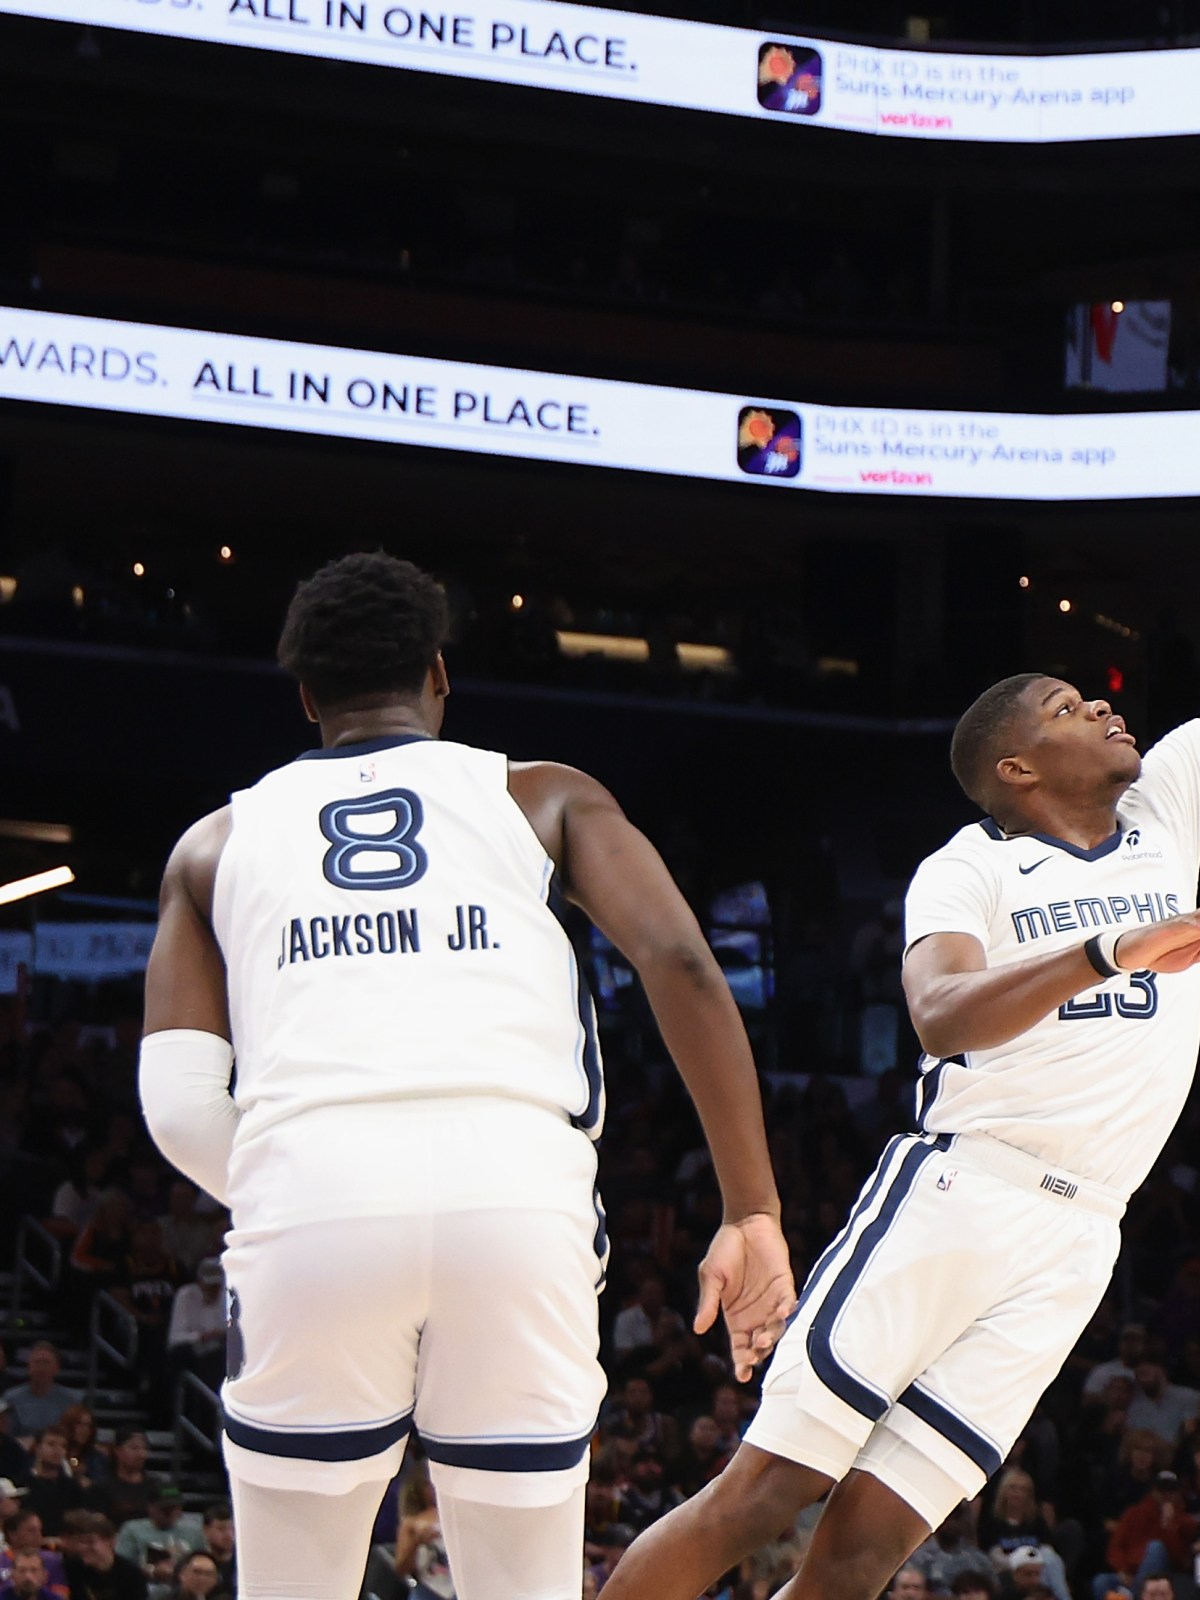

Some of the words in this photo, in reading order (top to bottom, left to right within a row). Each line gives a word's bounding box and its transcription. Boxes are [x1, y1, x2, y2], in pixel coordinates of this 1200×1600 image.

[229, 0, 309, 26] ALL
[325, 0, 366, 31] IN
[383, 7, 474, 48] ONE
[491, 21, 637, 71] PLACE.
[926, 61, 943, 82] is
[950, 63, 972, 83] in
[979, 66, 1020, 84] the
[1090, 88, 1136, 106] app
[193, 360, 274, 399] ALL
[288, 370, 330, 403] IN
[345, 379, 438, 418] ONE
[452, 391, 600, 436] PLACE.
[905, 420, 922, 438] is
[930, 420, 952, 438] in
[959, 420, 999, 440] the
[1070, 446, 1116, 465] app
[319, 787, 428, 890] 8
[277, 907, 421, 971] JACKSON
[447, 904, 500, 951] JR.
[1011, 893, 1181, 944] MEMPHIS
